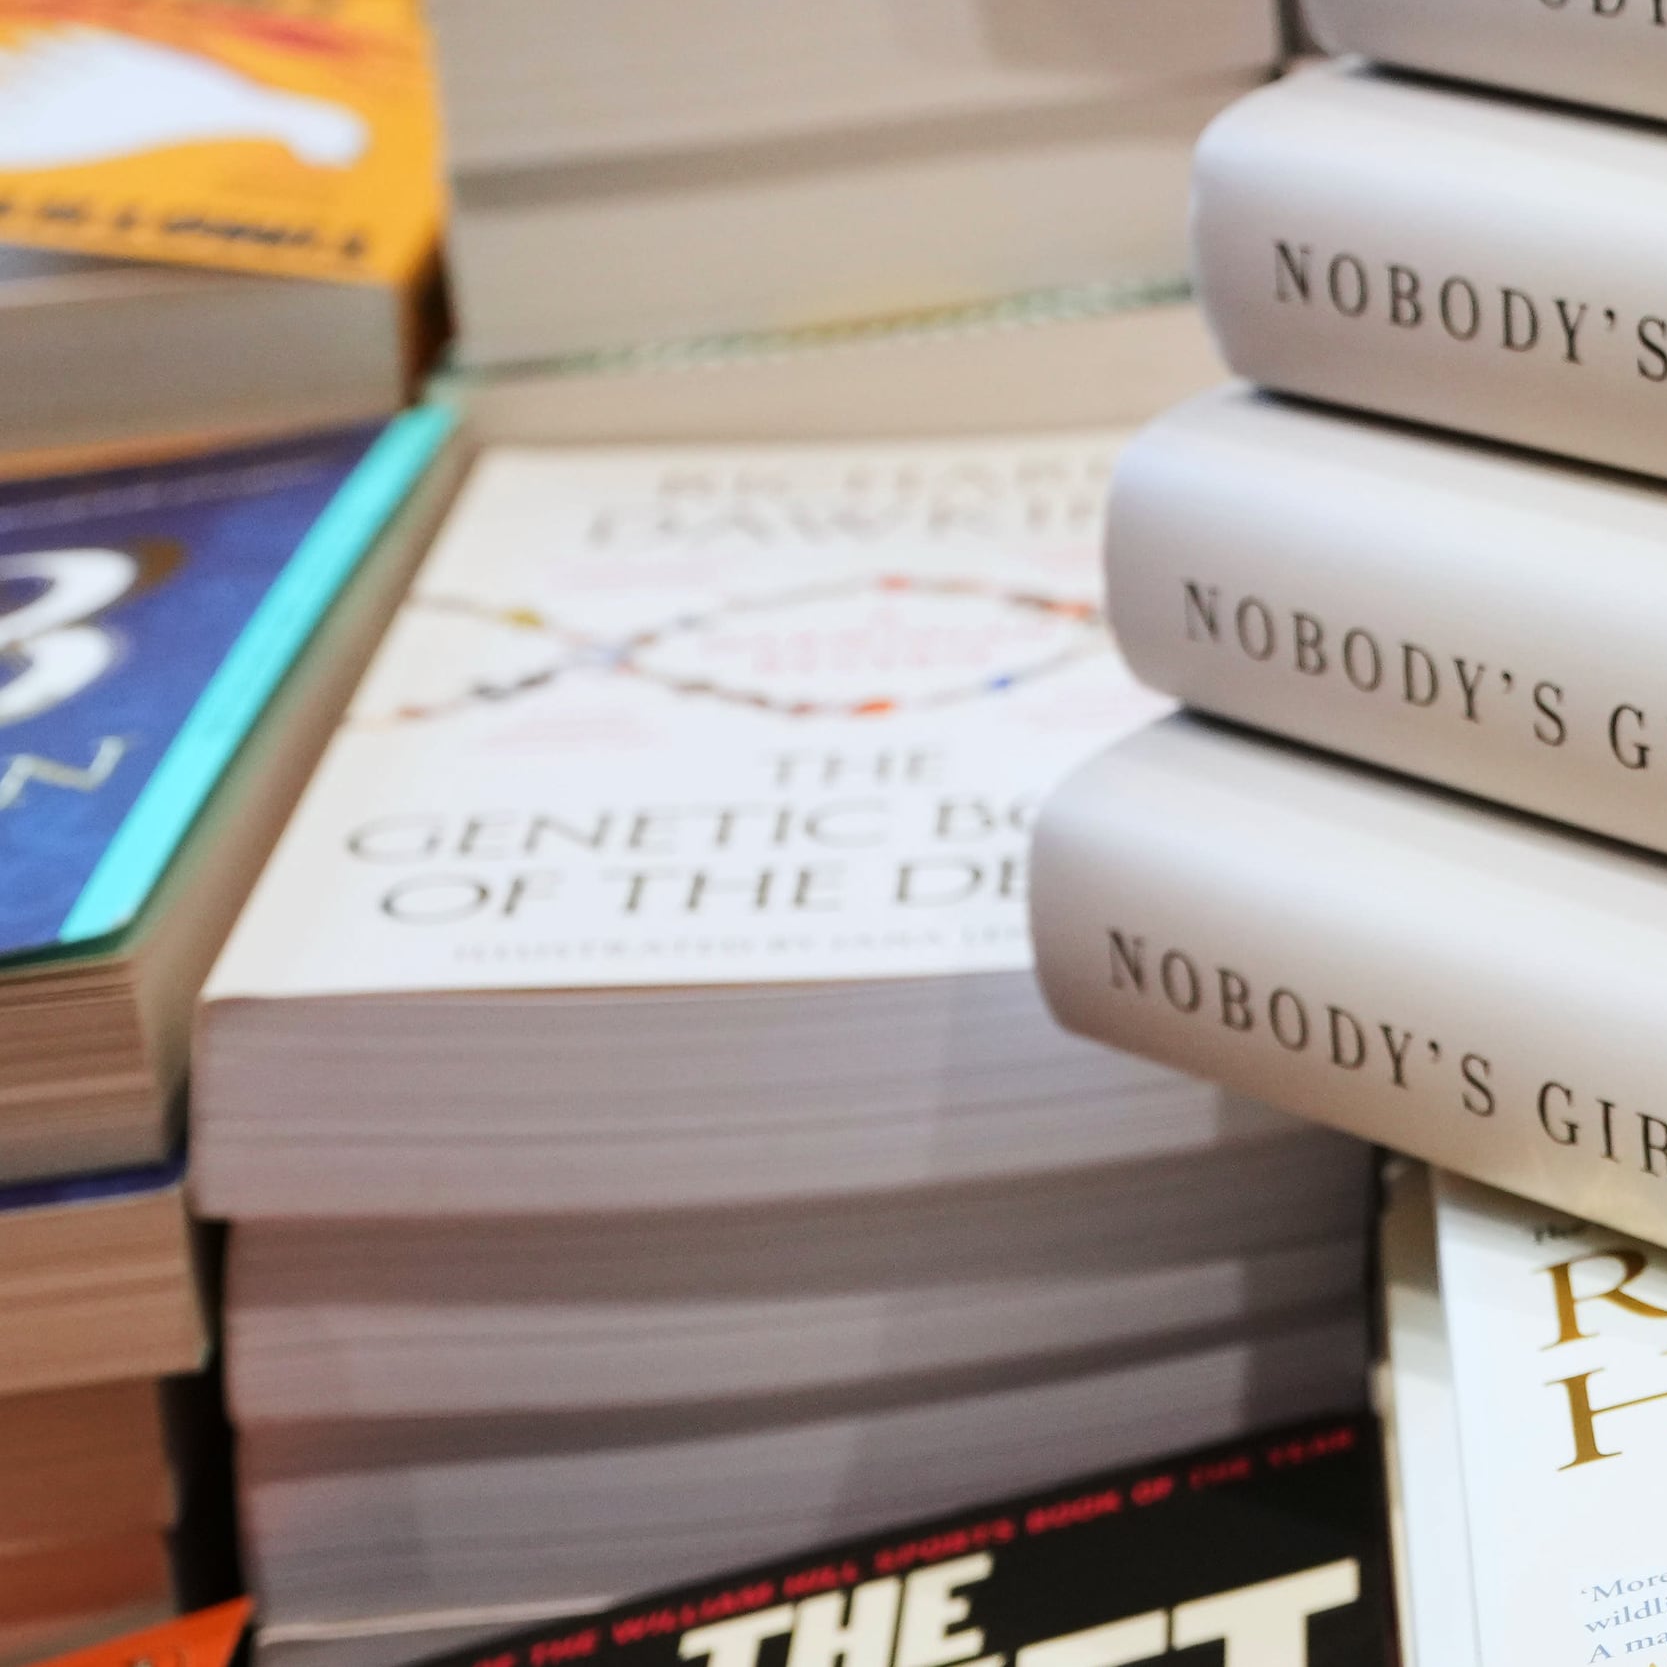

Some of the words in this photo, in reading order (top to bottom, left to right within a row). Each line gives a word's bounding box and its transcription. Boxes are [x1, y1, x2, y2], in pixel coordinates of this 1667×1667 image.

[772, 748, 944, 790] THE
[345, 802, 900, 868] GENETIC
[380, 874, 550, 926] OF
[610, 864, 848, 916] THE
[1586, 1643, 1615, 1665] A
